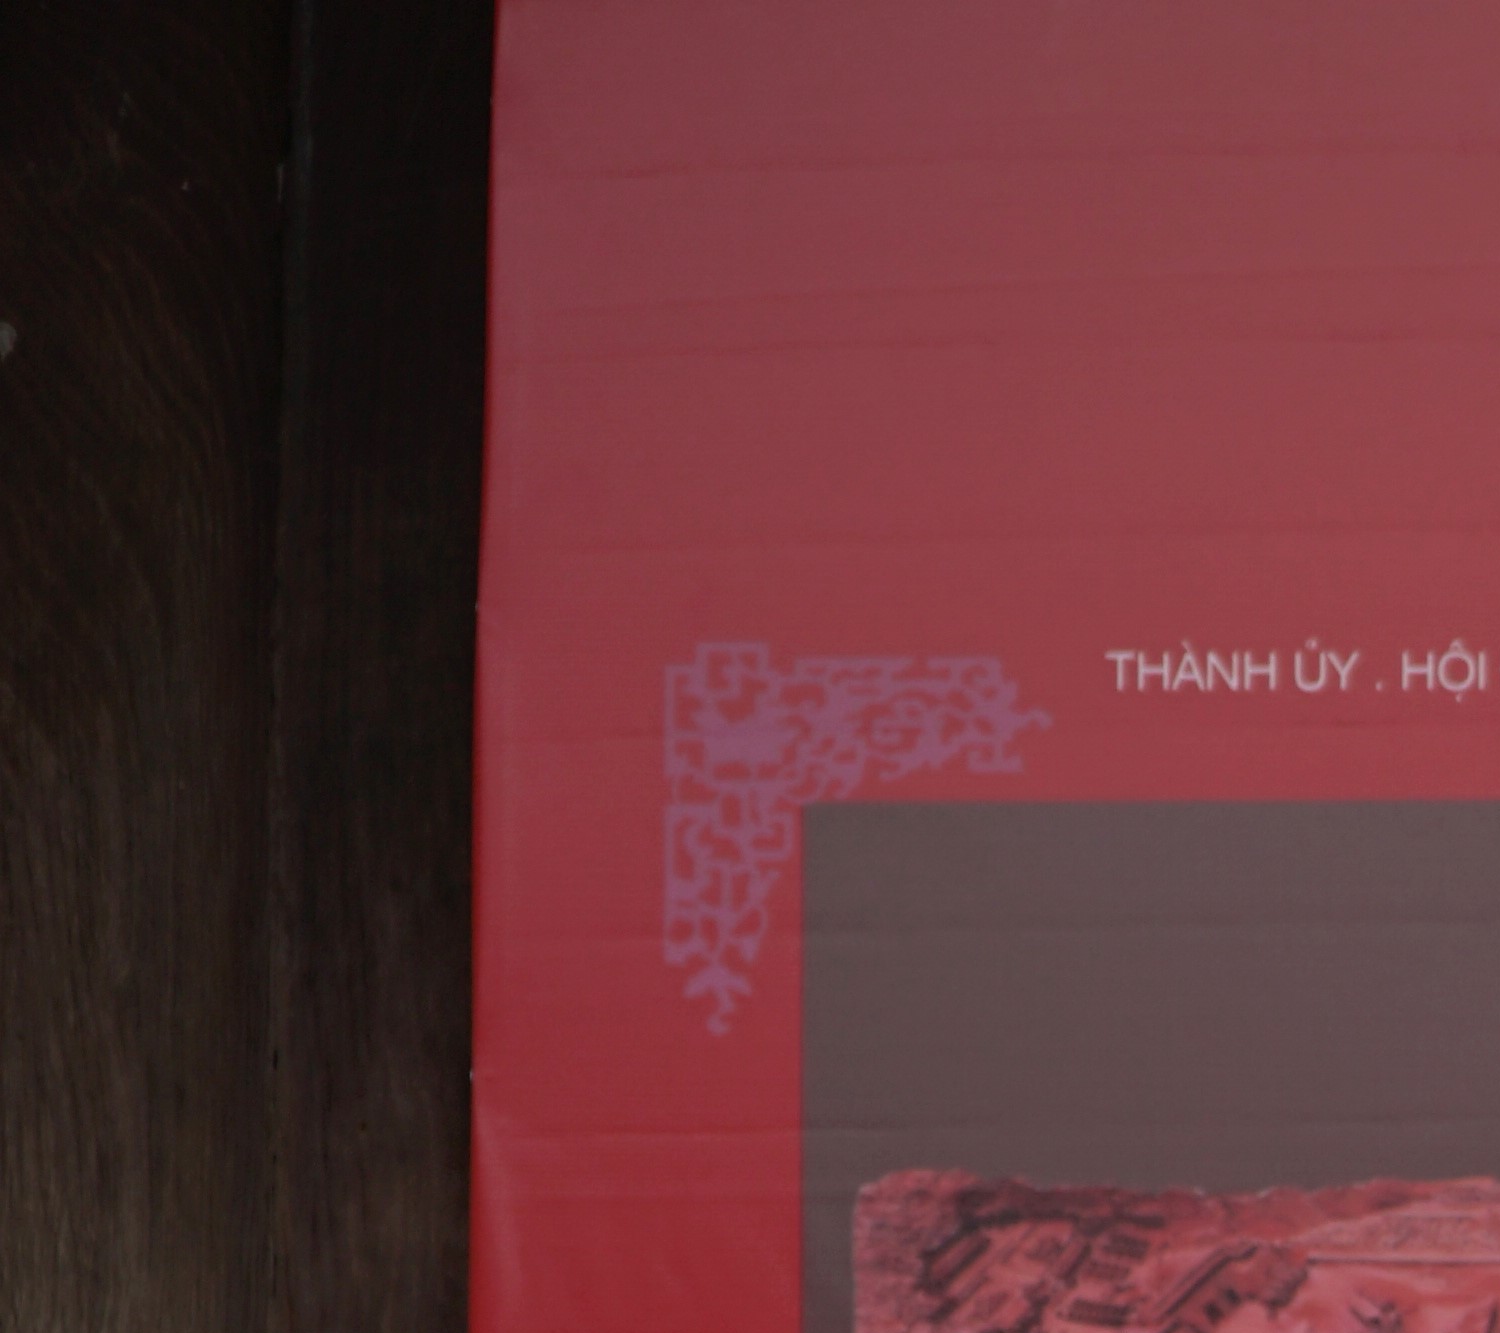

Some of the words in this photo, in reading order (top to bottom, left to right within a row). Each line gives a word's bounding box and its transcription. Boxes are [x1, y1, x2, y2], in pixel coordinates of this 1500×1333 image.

[1103, 638, 1281, 692] THÀNH
[1293, 636, 1362, 693] ỦY
[1400, 637, 1490, 703] HỘI
